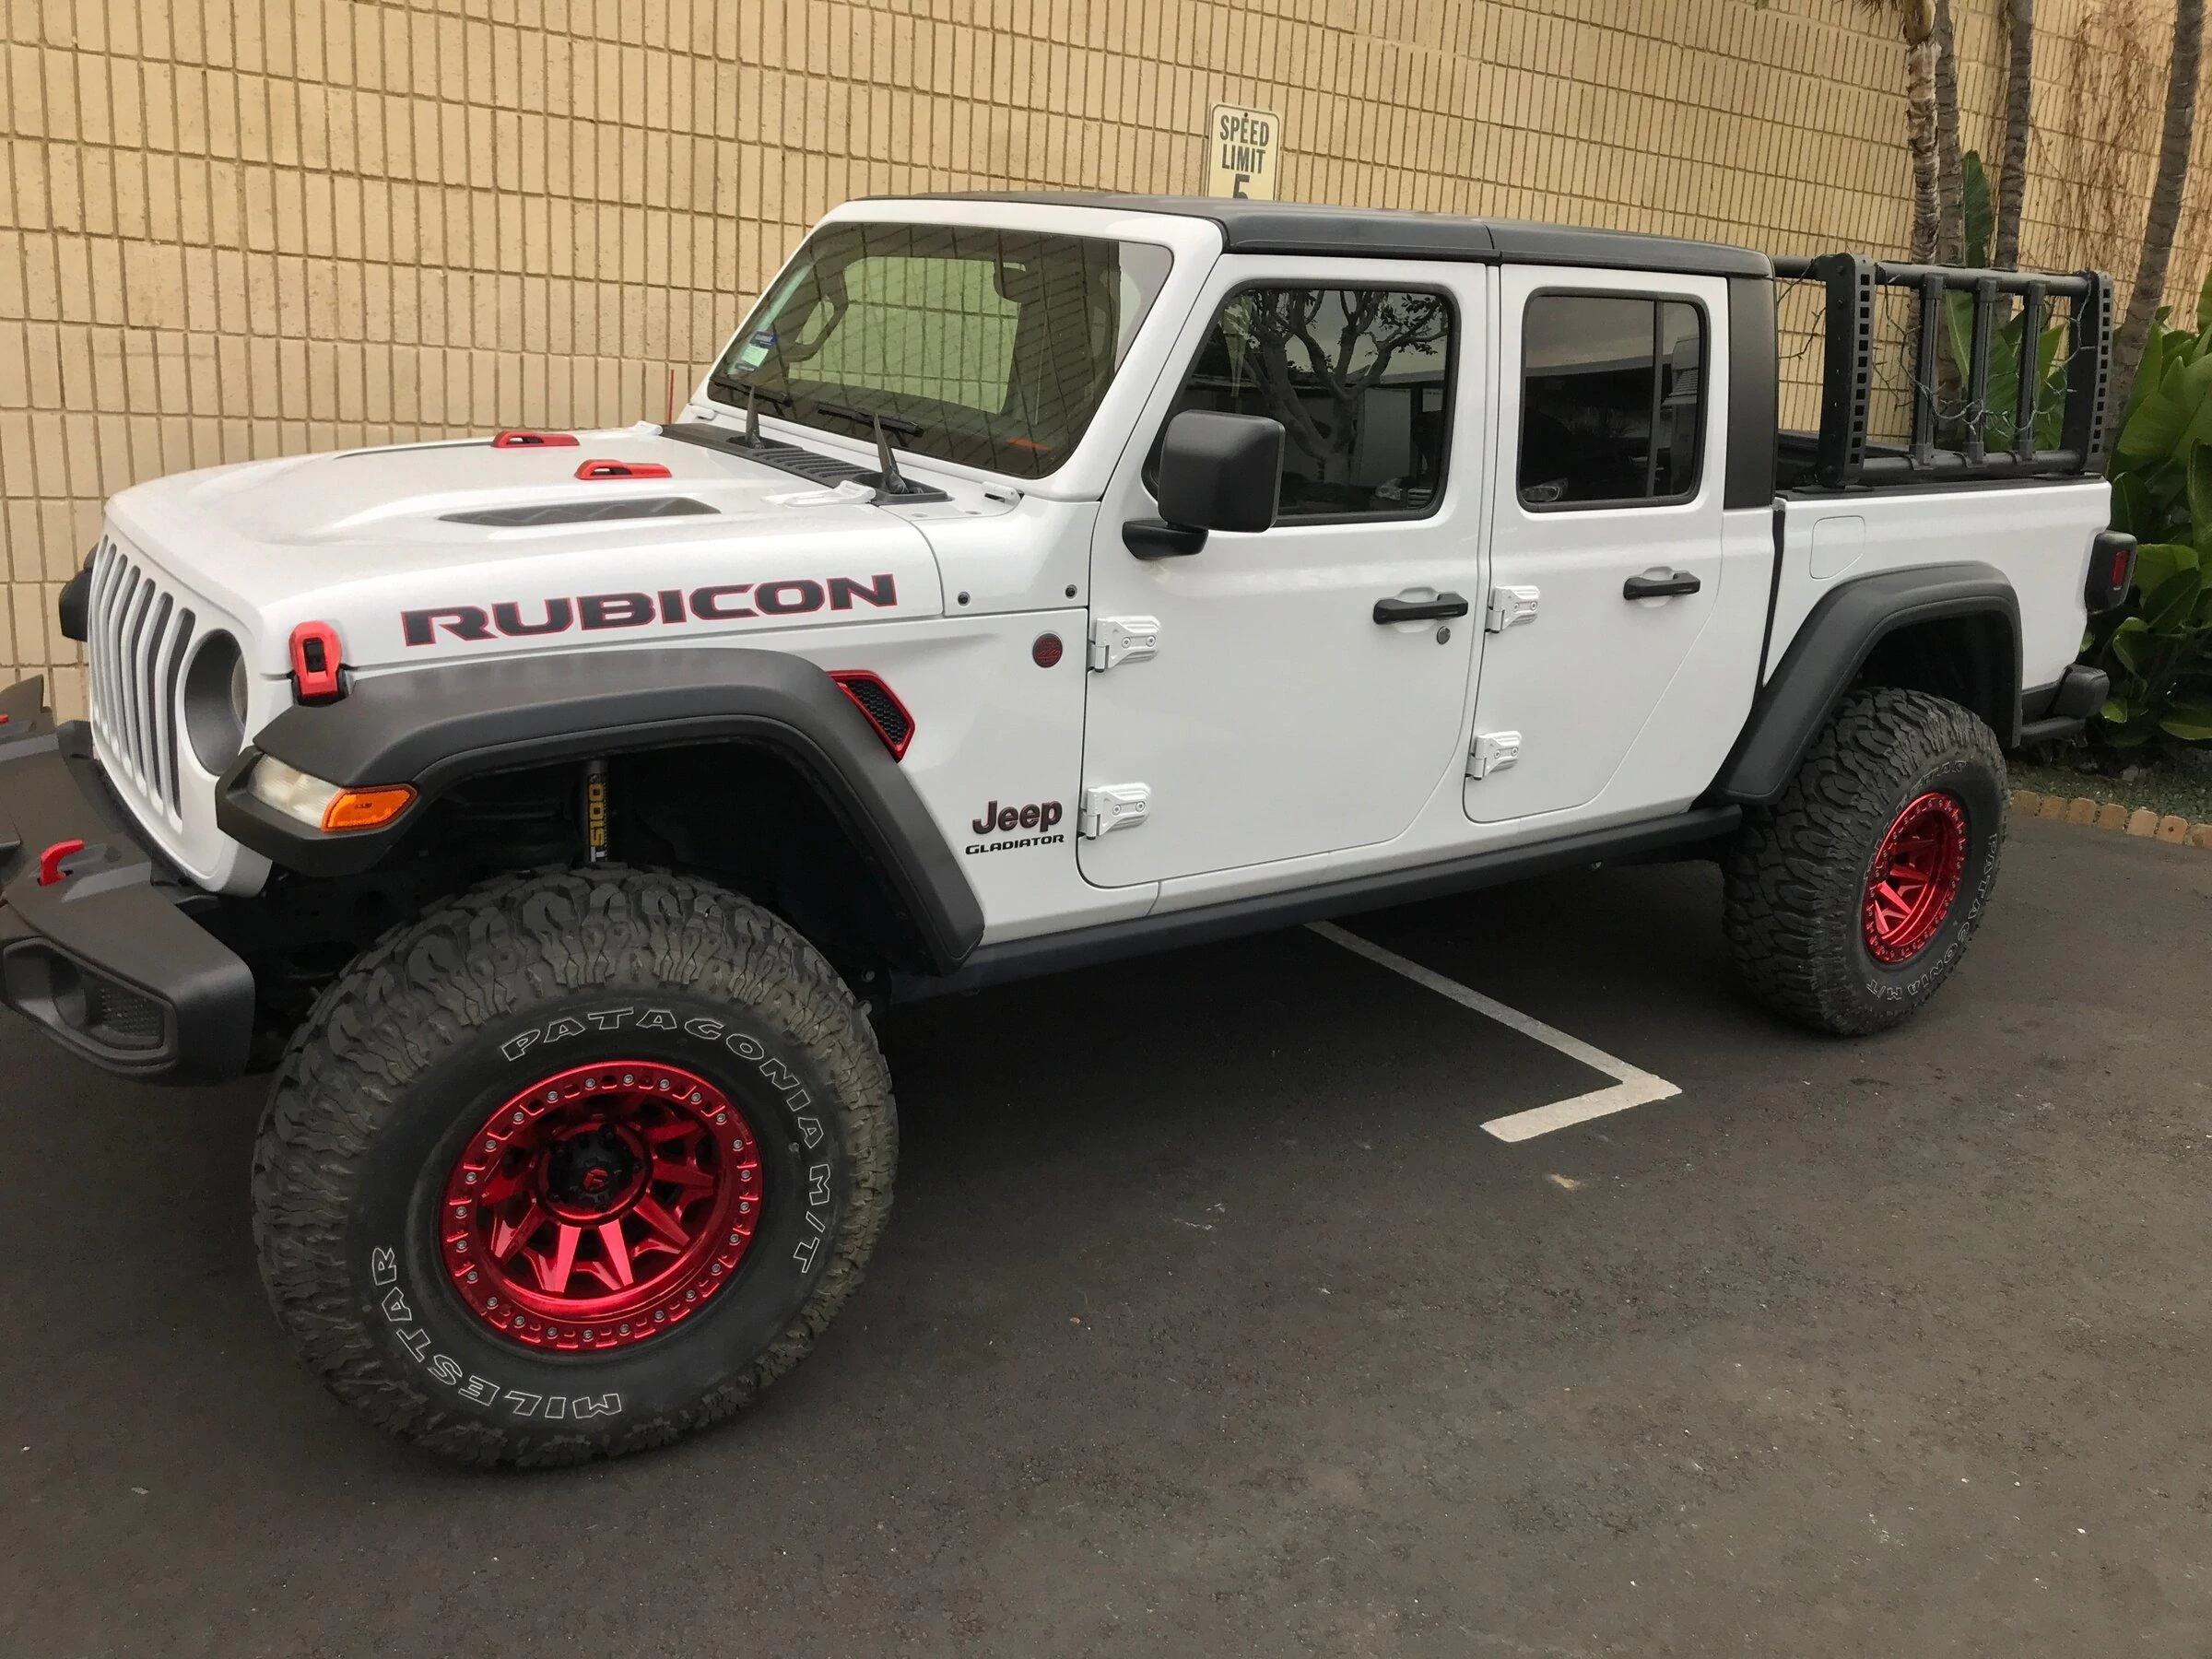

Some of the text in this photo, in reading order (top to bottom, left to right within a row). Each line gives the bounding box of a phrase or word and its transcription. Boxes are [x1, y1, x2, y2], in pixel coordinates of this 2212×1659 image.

[1219, 114, 1269, 147] SPEED
[1221, 144, 1266, 174] LIMIT
[400, 573, 899, 647] RUBICON
[971, 800, 1063, 834] Jeep
[965, 834, 1065, 855] GLADIATOR
[500, 1006, 824, 1149] PATAGONIA
[371, 1246, 622, 1419] MILESTAR
